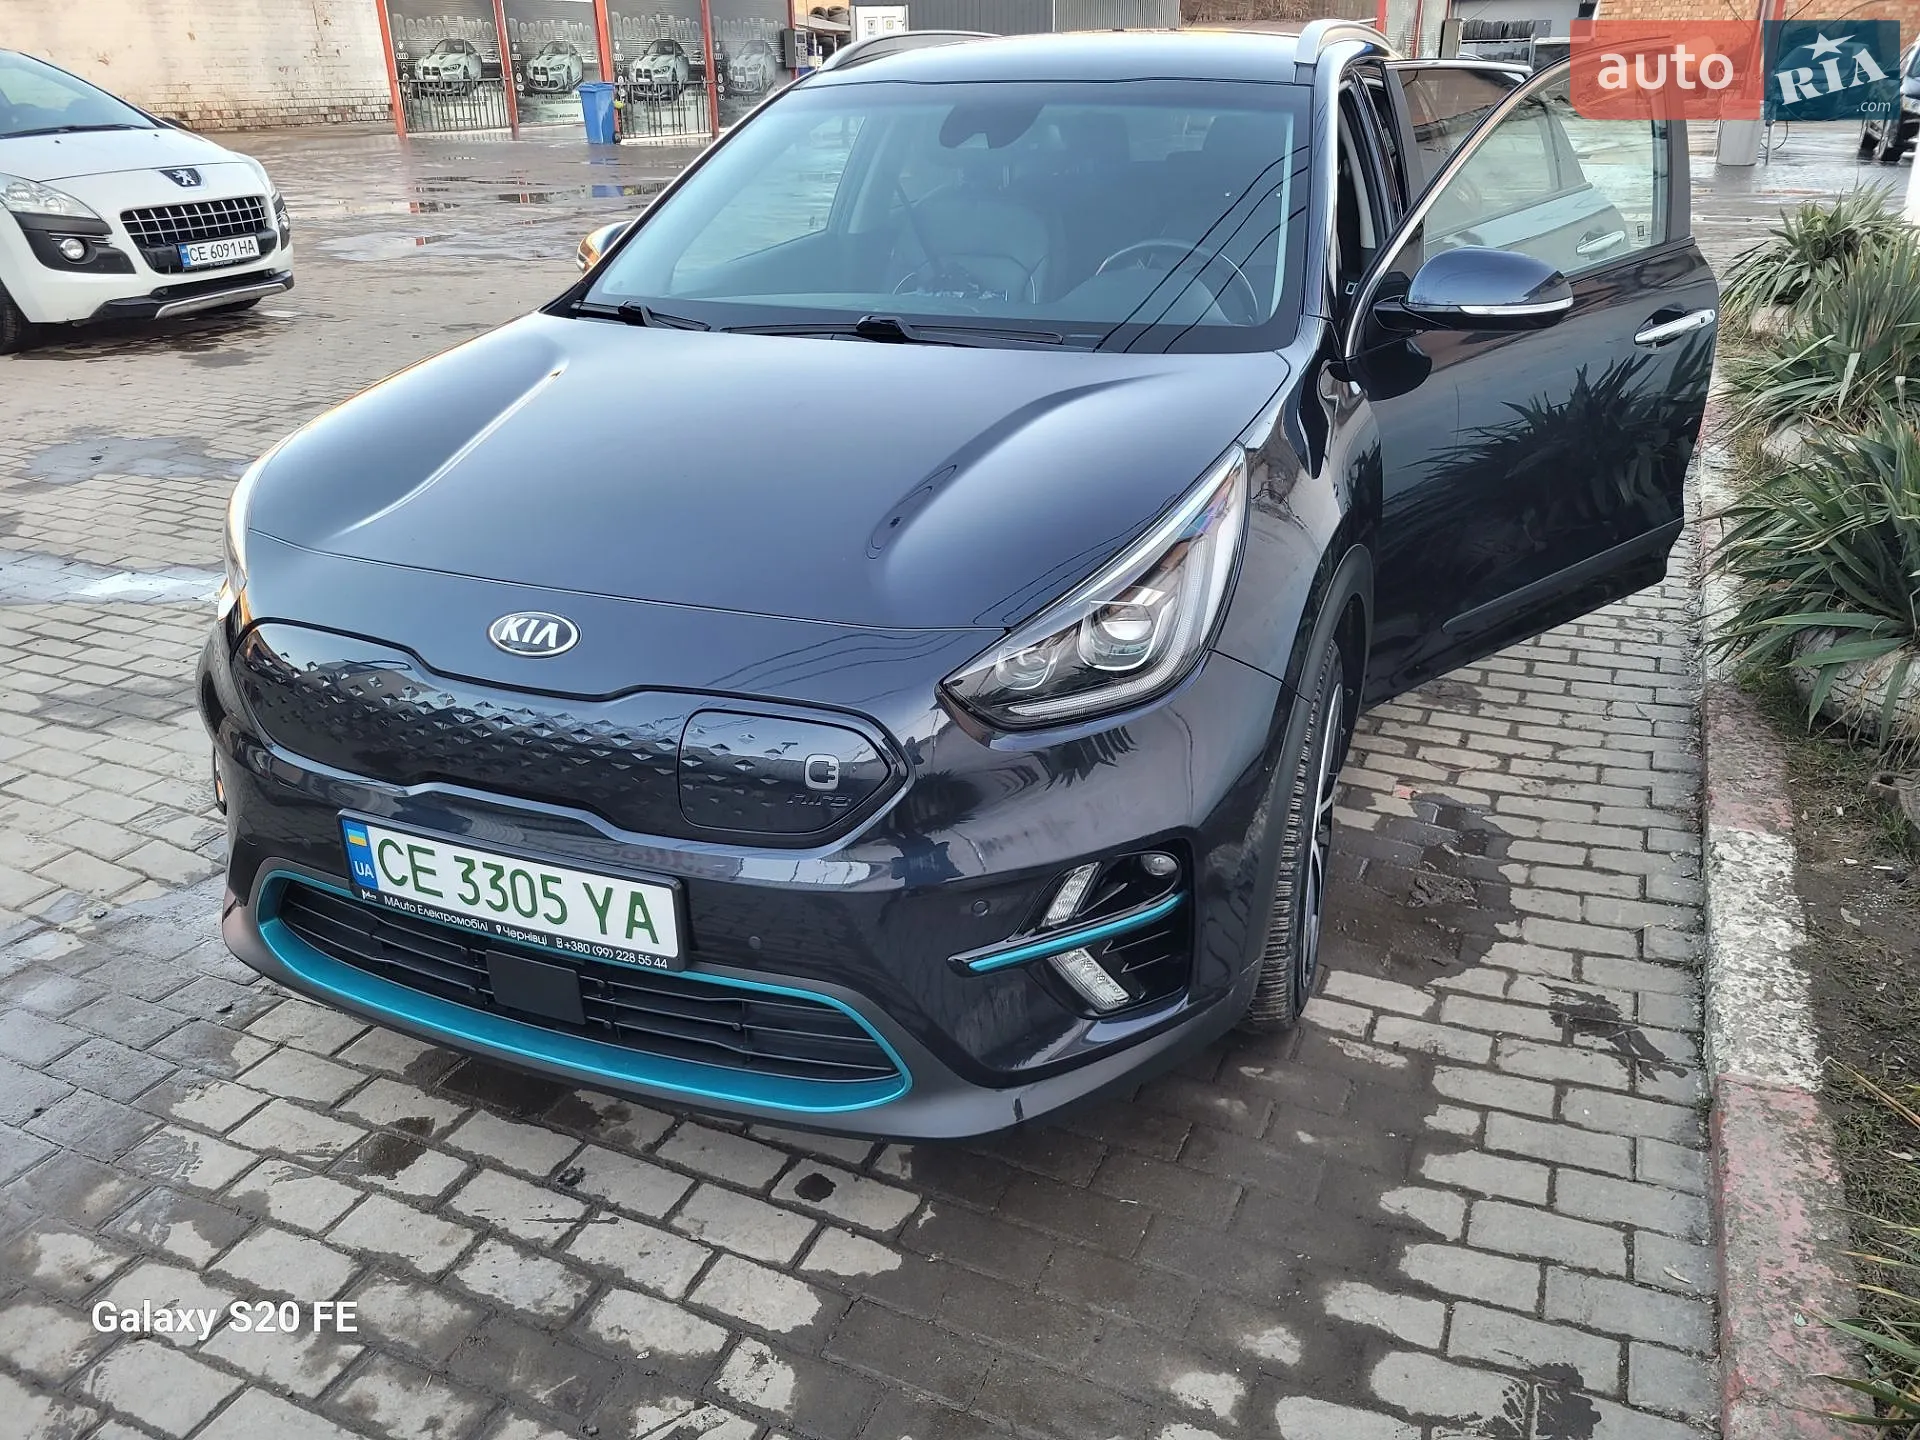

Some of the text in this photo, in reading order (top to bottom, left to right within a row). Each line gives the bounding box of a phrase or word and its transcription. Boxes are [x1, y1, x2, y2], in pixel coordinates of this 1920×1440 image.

[189, 240, 255, 261] CE 6091 HA
[500, 616, 558, 648] KIA
[354, 860, 375, 878] UA
[377, 838, 659, 944] CE 3305 YA
[384, 895, 668, 969] MAuto Електромобілі Чернівці +380 (99) 228 55 44
